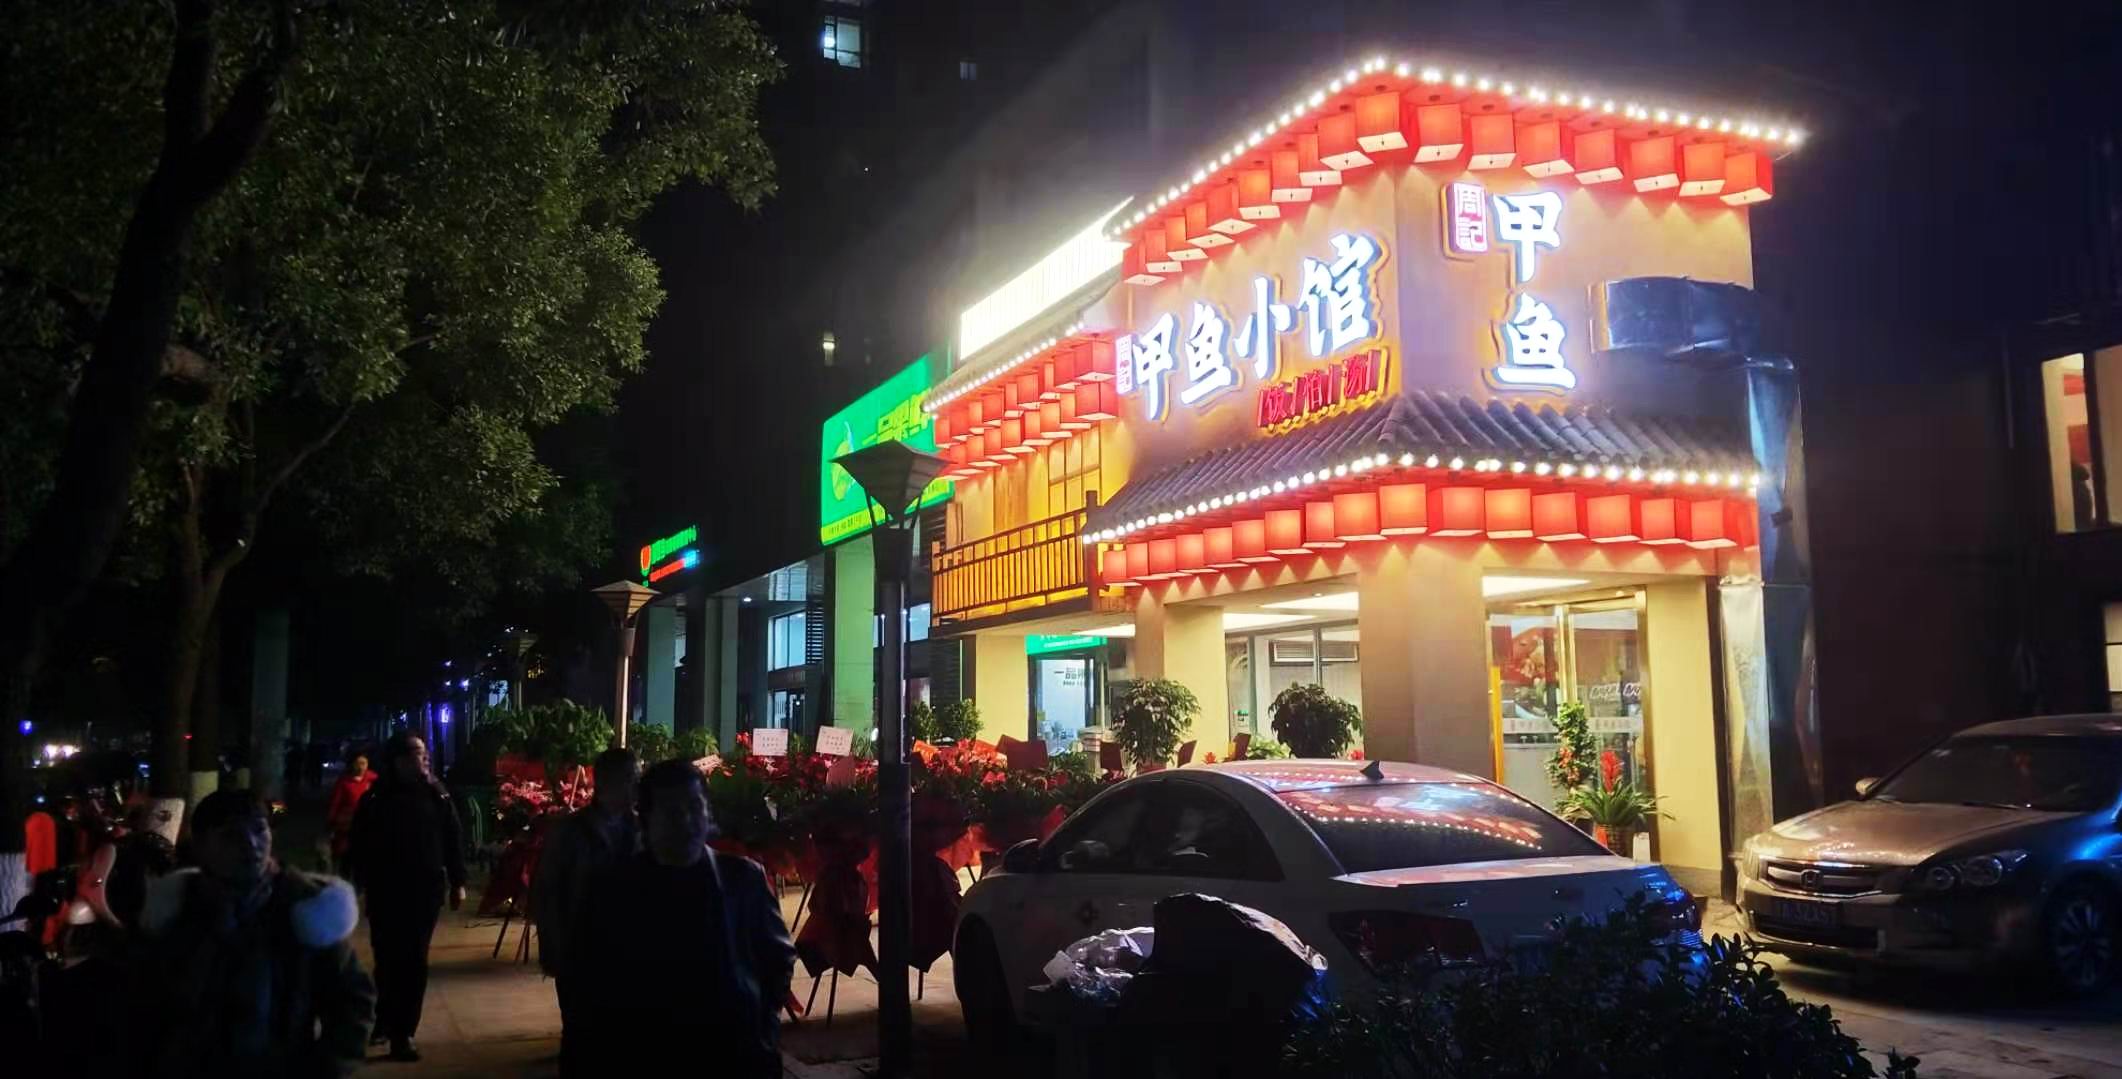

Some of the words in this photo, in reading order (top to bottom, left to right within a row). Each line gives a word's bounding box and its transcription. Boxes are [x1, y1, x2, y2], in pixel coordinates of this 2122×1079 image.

[1133, 233, 1375, 420] 甲鱼小馆
[1492, 191, 1576, 389] 甲鱼
